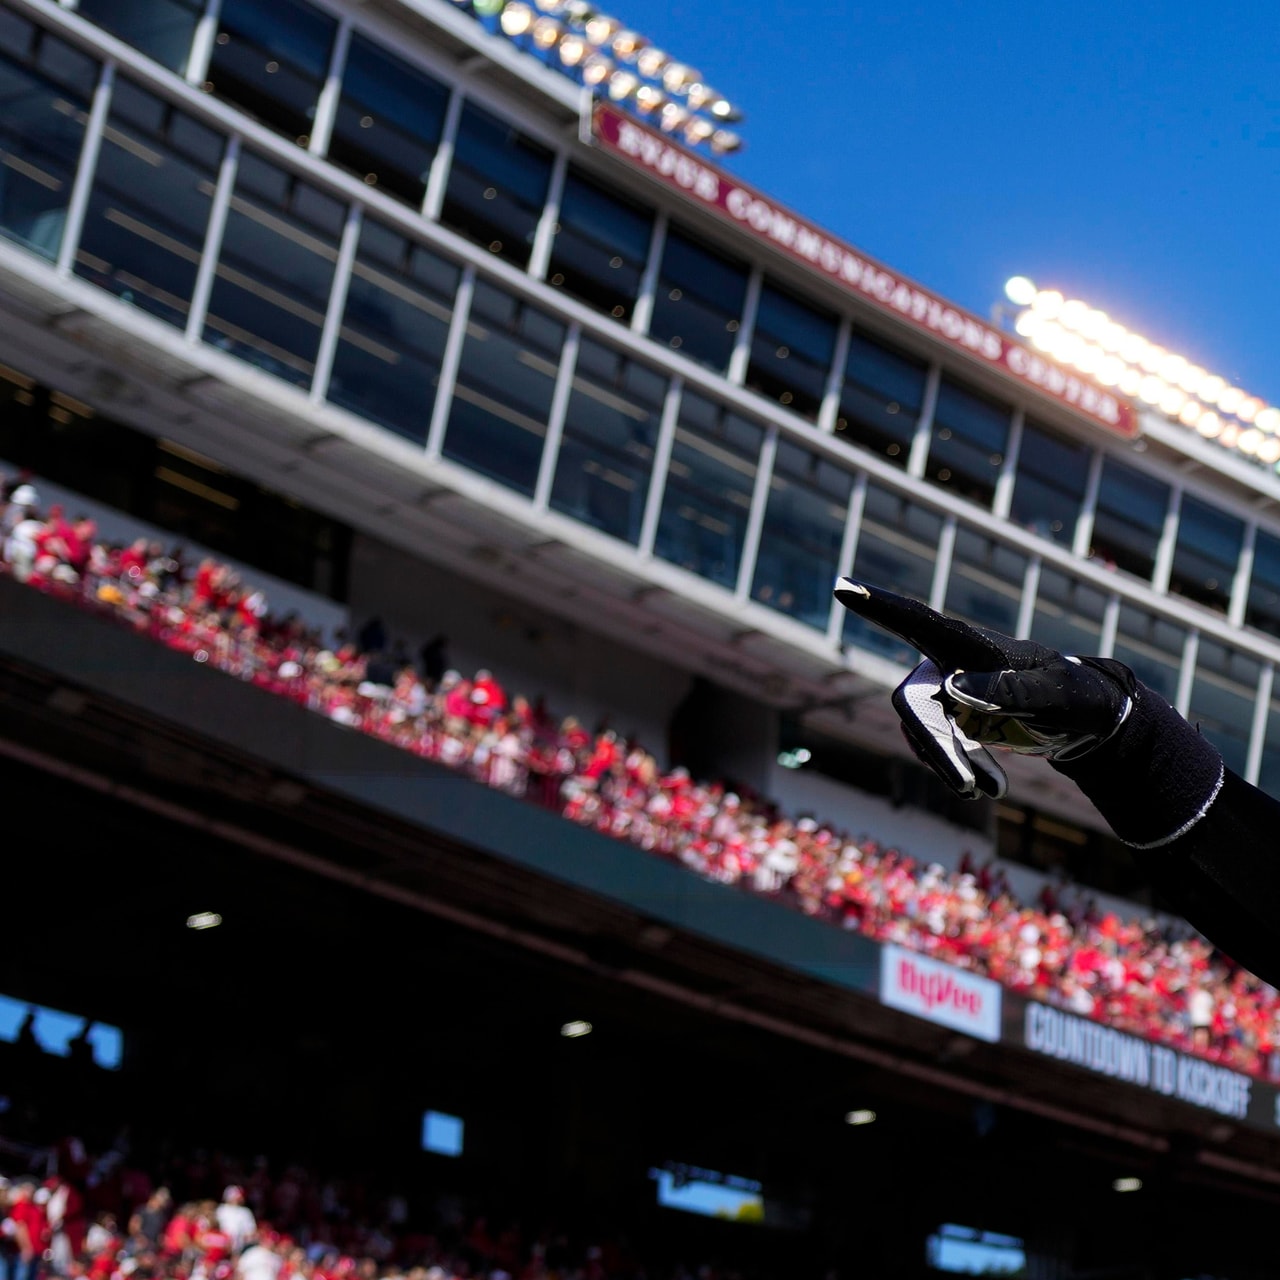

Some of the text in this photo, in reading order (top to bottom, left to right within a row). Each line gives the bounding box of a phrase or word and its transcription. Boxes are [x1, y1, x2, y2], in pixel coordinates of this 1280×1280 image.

[1005, 343, 1123, 425] CENTER
[1025, 1001, 1252, 1120] COUNTDOWN TO KICKOFF
